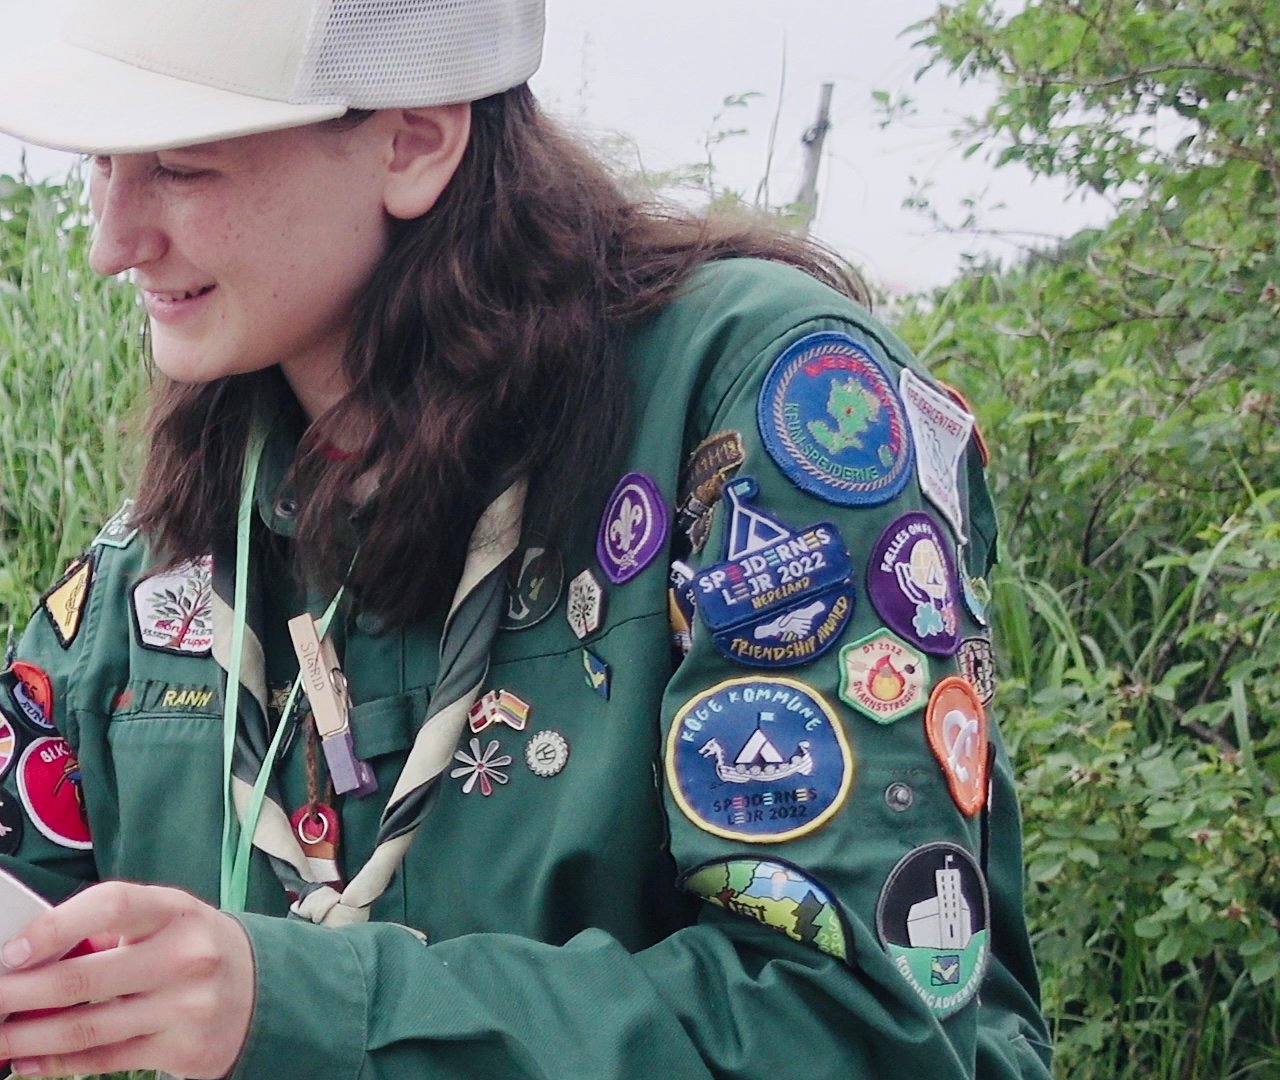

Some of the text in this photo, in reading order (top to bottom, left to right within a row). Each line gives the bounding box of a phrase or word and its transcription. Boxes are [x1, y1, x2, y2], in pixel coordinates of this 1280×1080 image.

[698, 528, 831, 594] SPEJDERNES
[721, 573, 775, 606] LEJR
[777, 551, 827, 584] 2022
[300, 641, 325, 691] SIGRID
[730, 637, 816, 660] FRIENDSHIP
[728, 688, 822, 732] KOMMUNE
[769, 805, 808, 819] 2022
